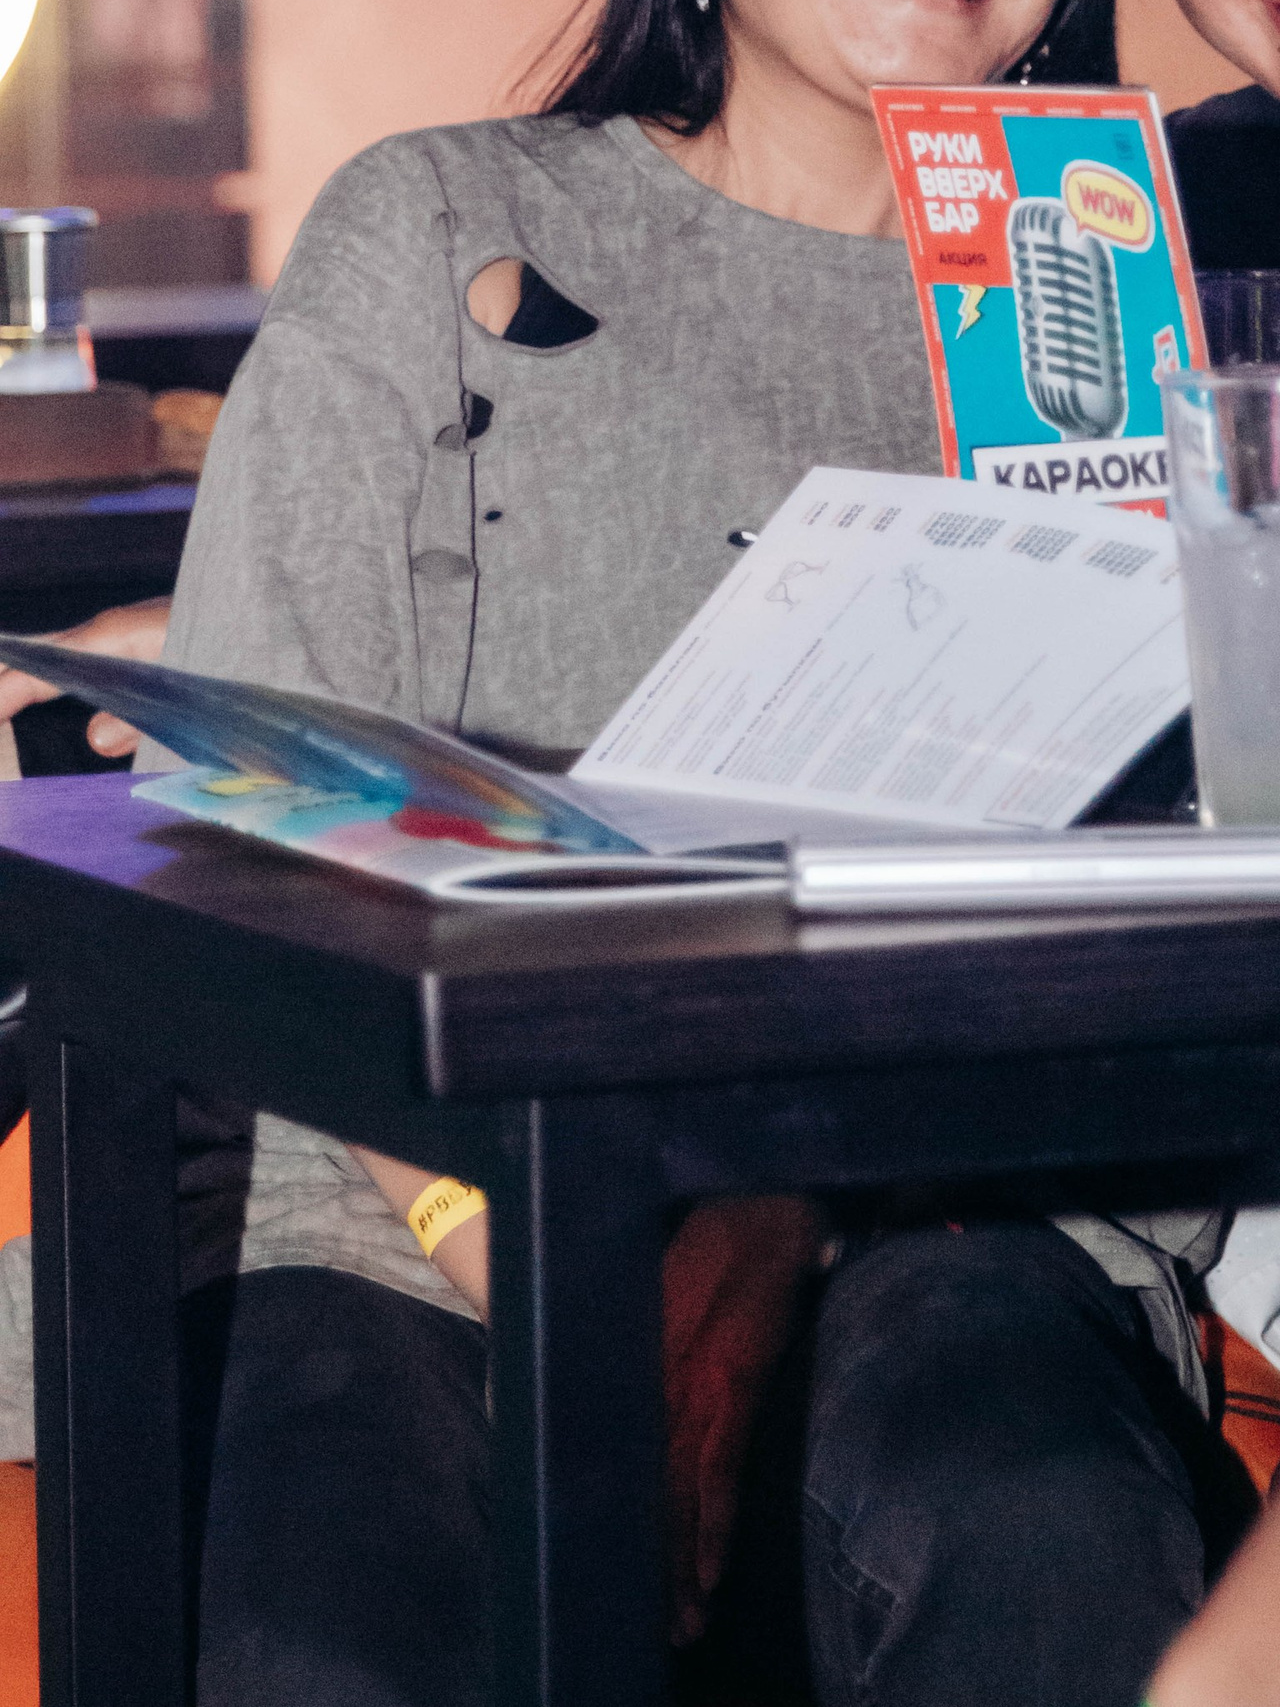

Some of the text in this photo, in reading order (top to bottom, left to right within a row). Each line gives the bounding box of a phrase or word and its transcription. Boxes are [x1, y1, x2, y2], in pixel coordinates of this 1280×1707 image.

[908, 131, 983, 164] РУКИ
[916, 167, 1008, 200] ВВЕРХ
[924, 202, 980, 234] БАР
[1078, 182, 1136, 226] WOW
